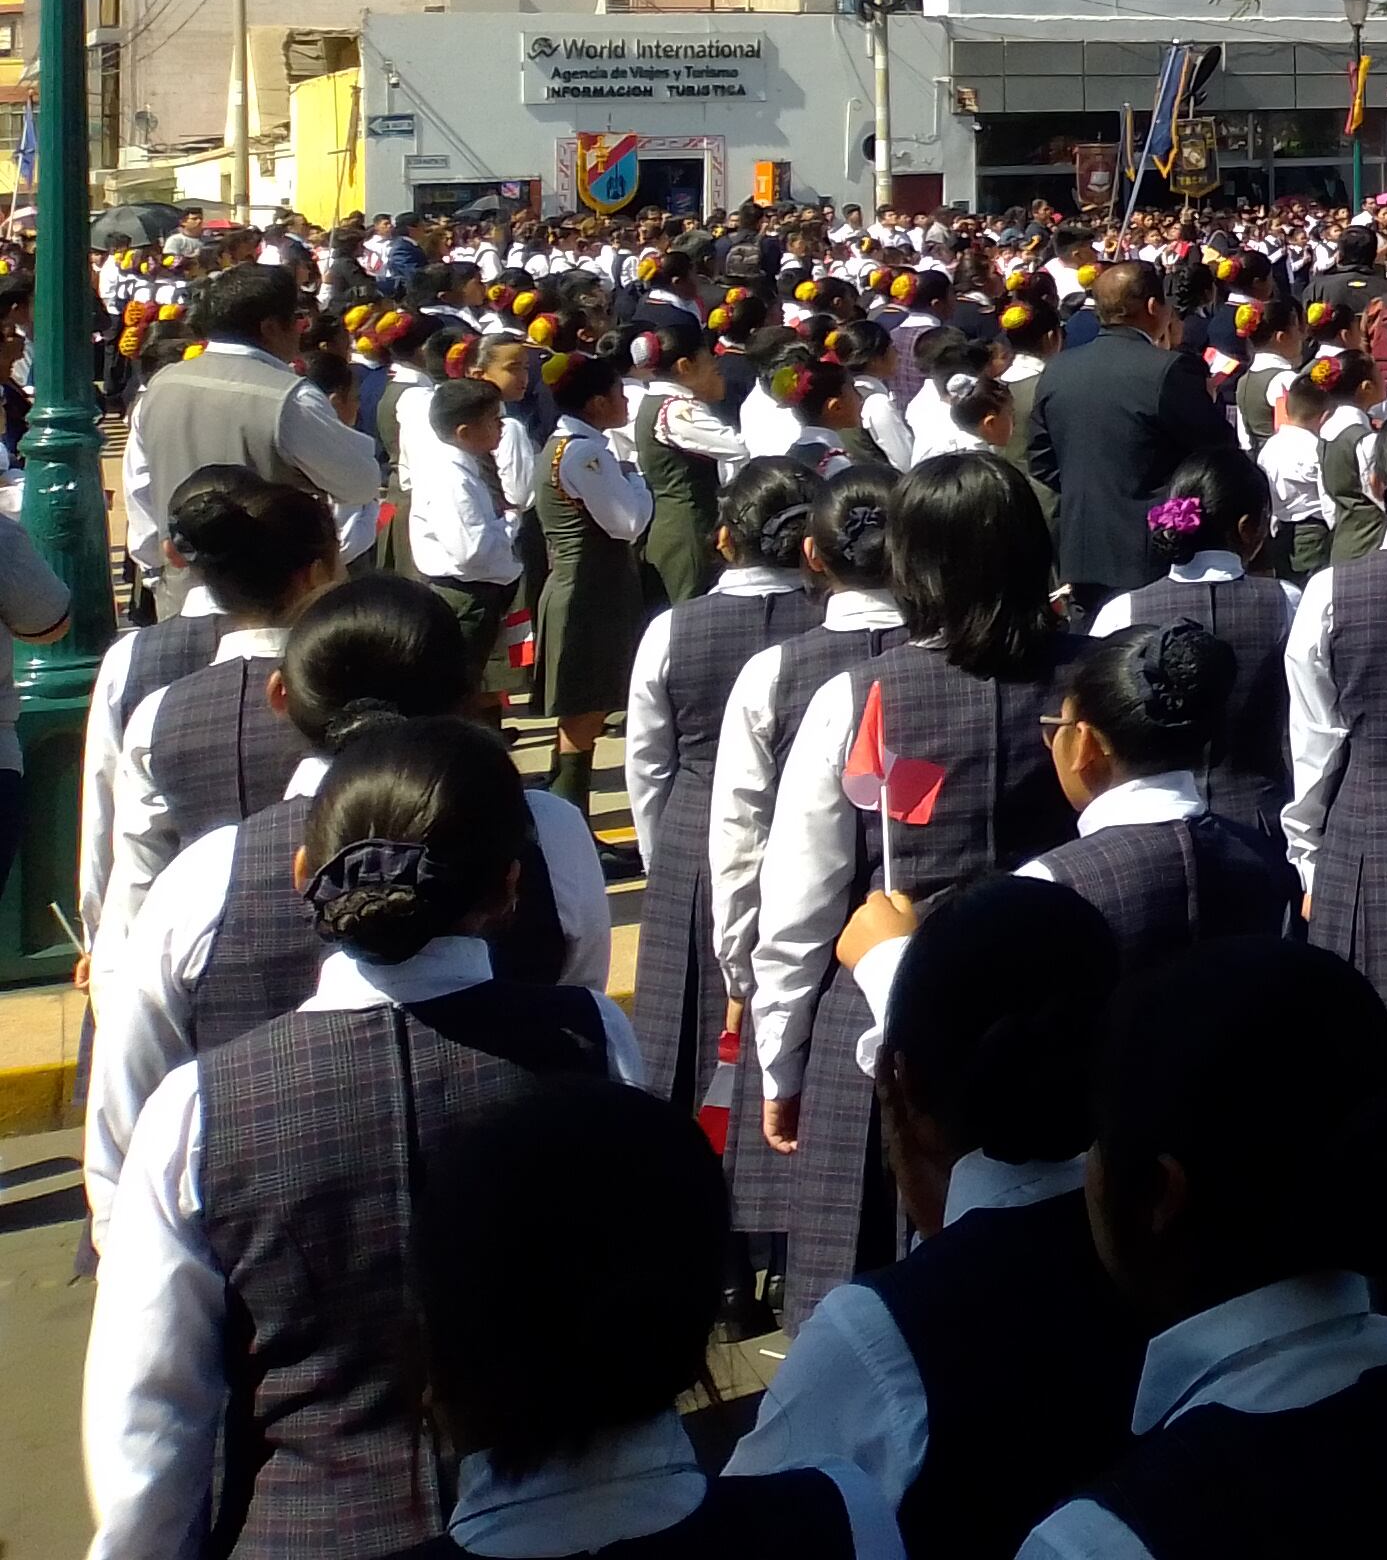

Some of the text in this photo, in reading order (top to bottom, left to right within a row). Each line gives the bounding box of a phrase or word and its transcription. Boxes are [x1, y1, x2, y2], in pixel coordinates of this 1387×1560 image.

[562, 38, 761, 59] World International
[551, 65, 739, 83] Agencia de Viajes y Turismo
[546, 84, 747, 100] INFORMACION TURISTICA
